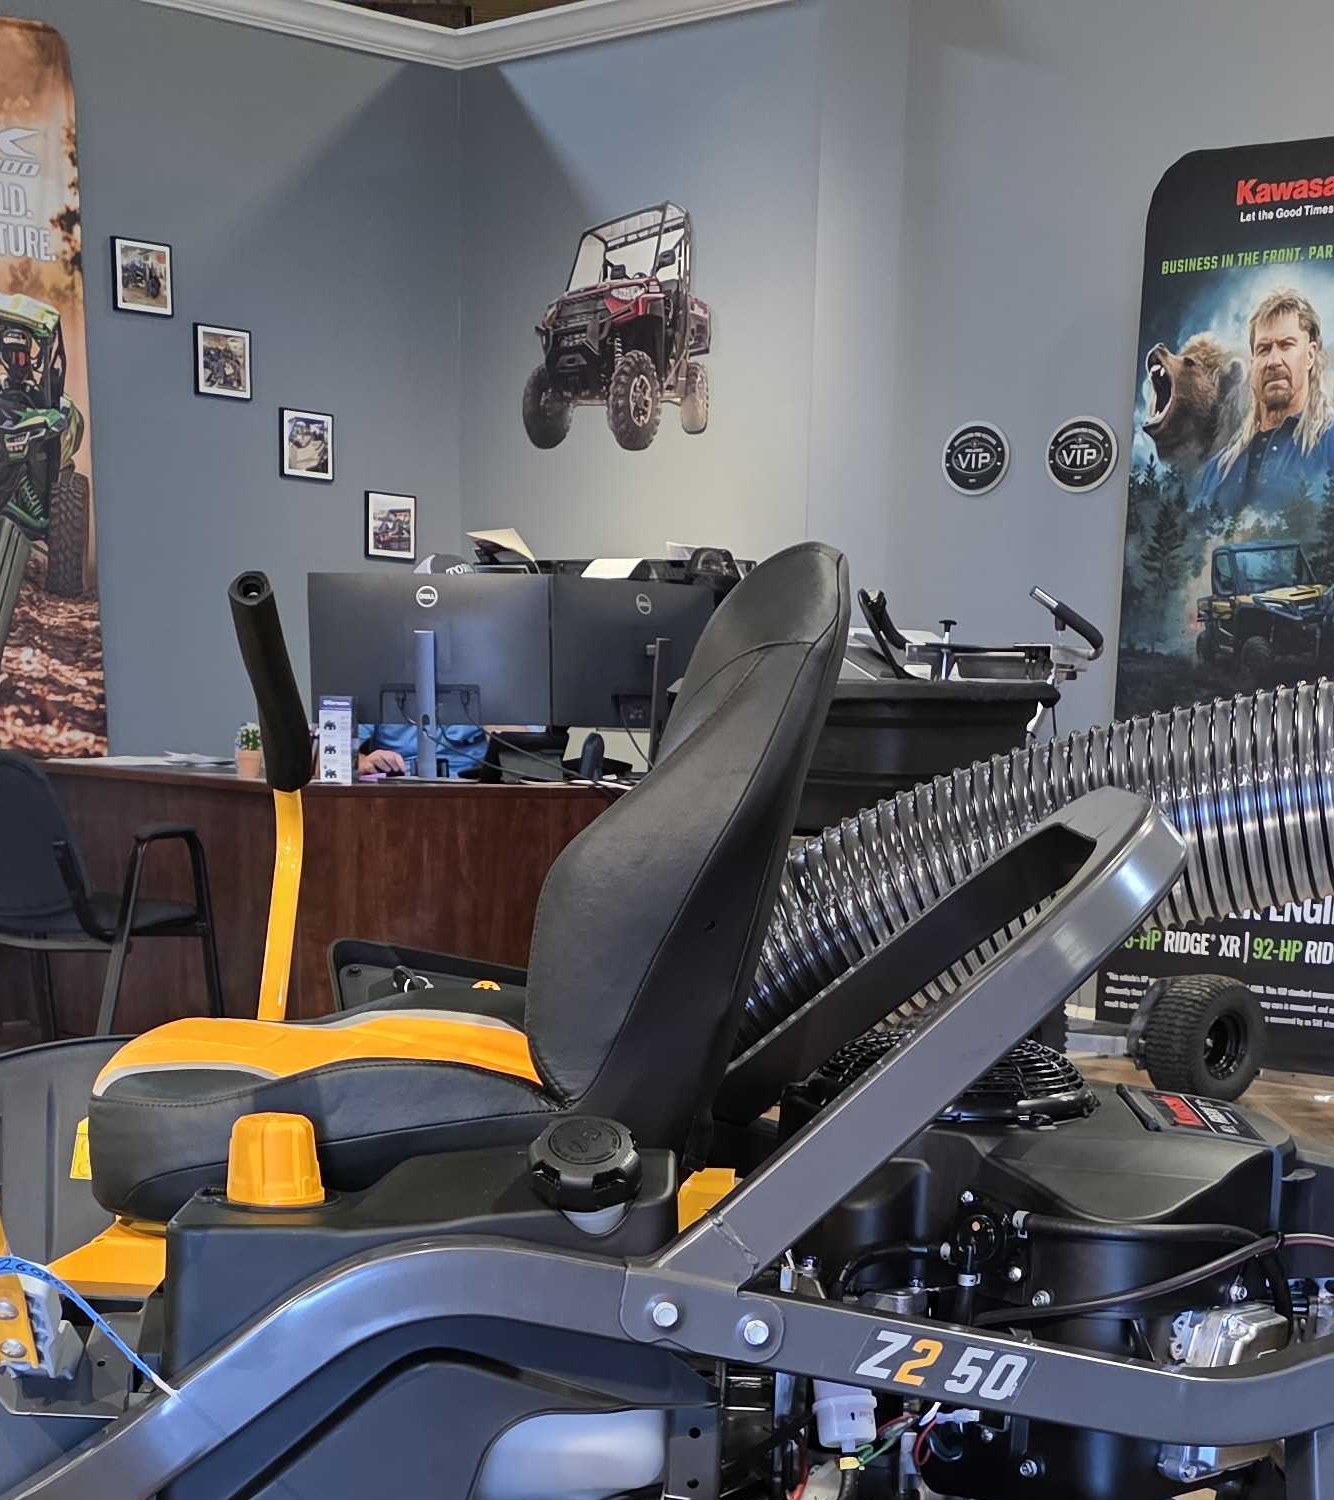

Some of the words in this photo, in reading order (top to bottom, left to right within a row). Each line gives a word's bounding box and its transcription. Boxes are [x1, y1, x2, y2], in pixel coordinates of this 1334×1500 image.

[1240, 210, 1256, 222] Let
[1258, 206, 1274, 220] the
[1276, 205, 1302, 218] Good
[1304, 203, 1334, 216] Times
[1161, 255, 1218, 274] BUSINESS
[1221, 254, 1234, 268] IN
[1237, 252, 1259, 267] THE
[1262, 248, 1304, 264] FRONT.
[957, 452, 991, 469] VIP
[1061, 449, 1098, 465] VIP
[1218, 934, 1241, 958] XR
[1253, 937, 1303, 963] 92-HP
